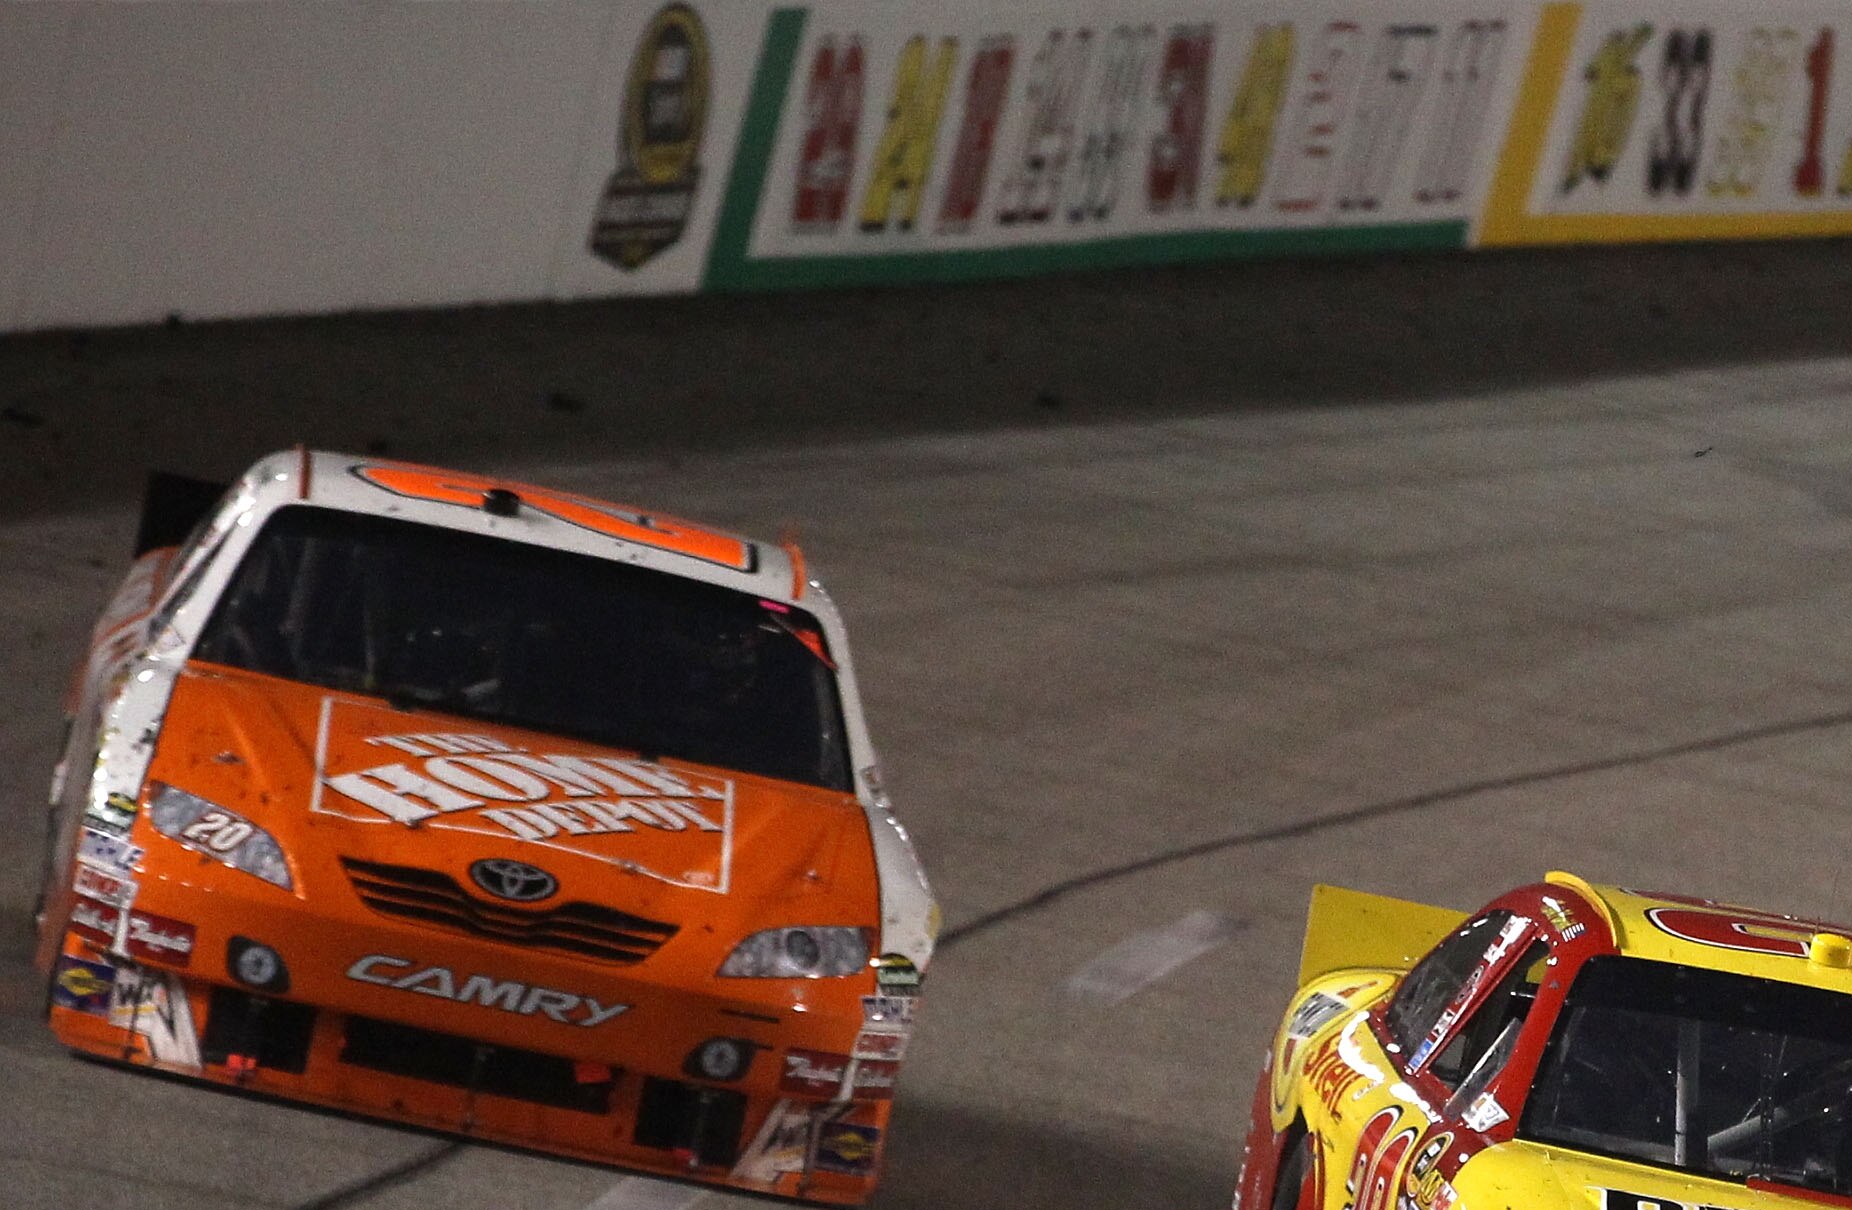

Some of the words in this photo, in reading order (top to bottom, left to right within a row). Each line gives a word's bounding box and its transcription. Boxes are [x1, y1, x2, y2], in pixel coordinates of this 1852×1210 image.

[324, 752, 724, 826] HOME
[183, 812, 253, 851] 20
[478, 799, 724, 841] DEPOT
[346, 954, 630, 1028] CAMRY
